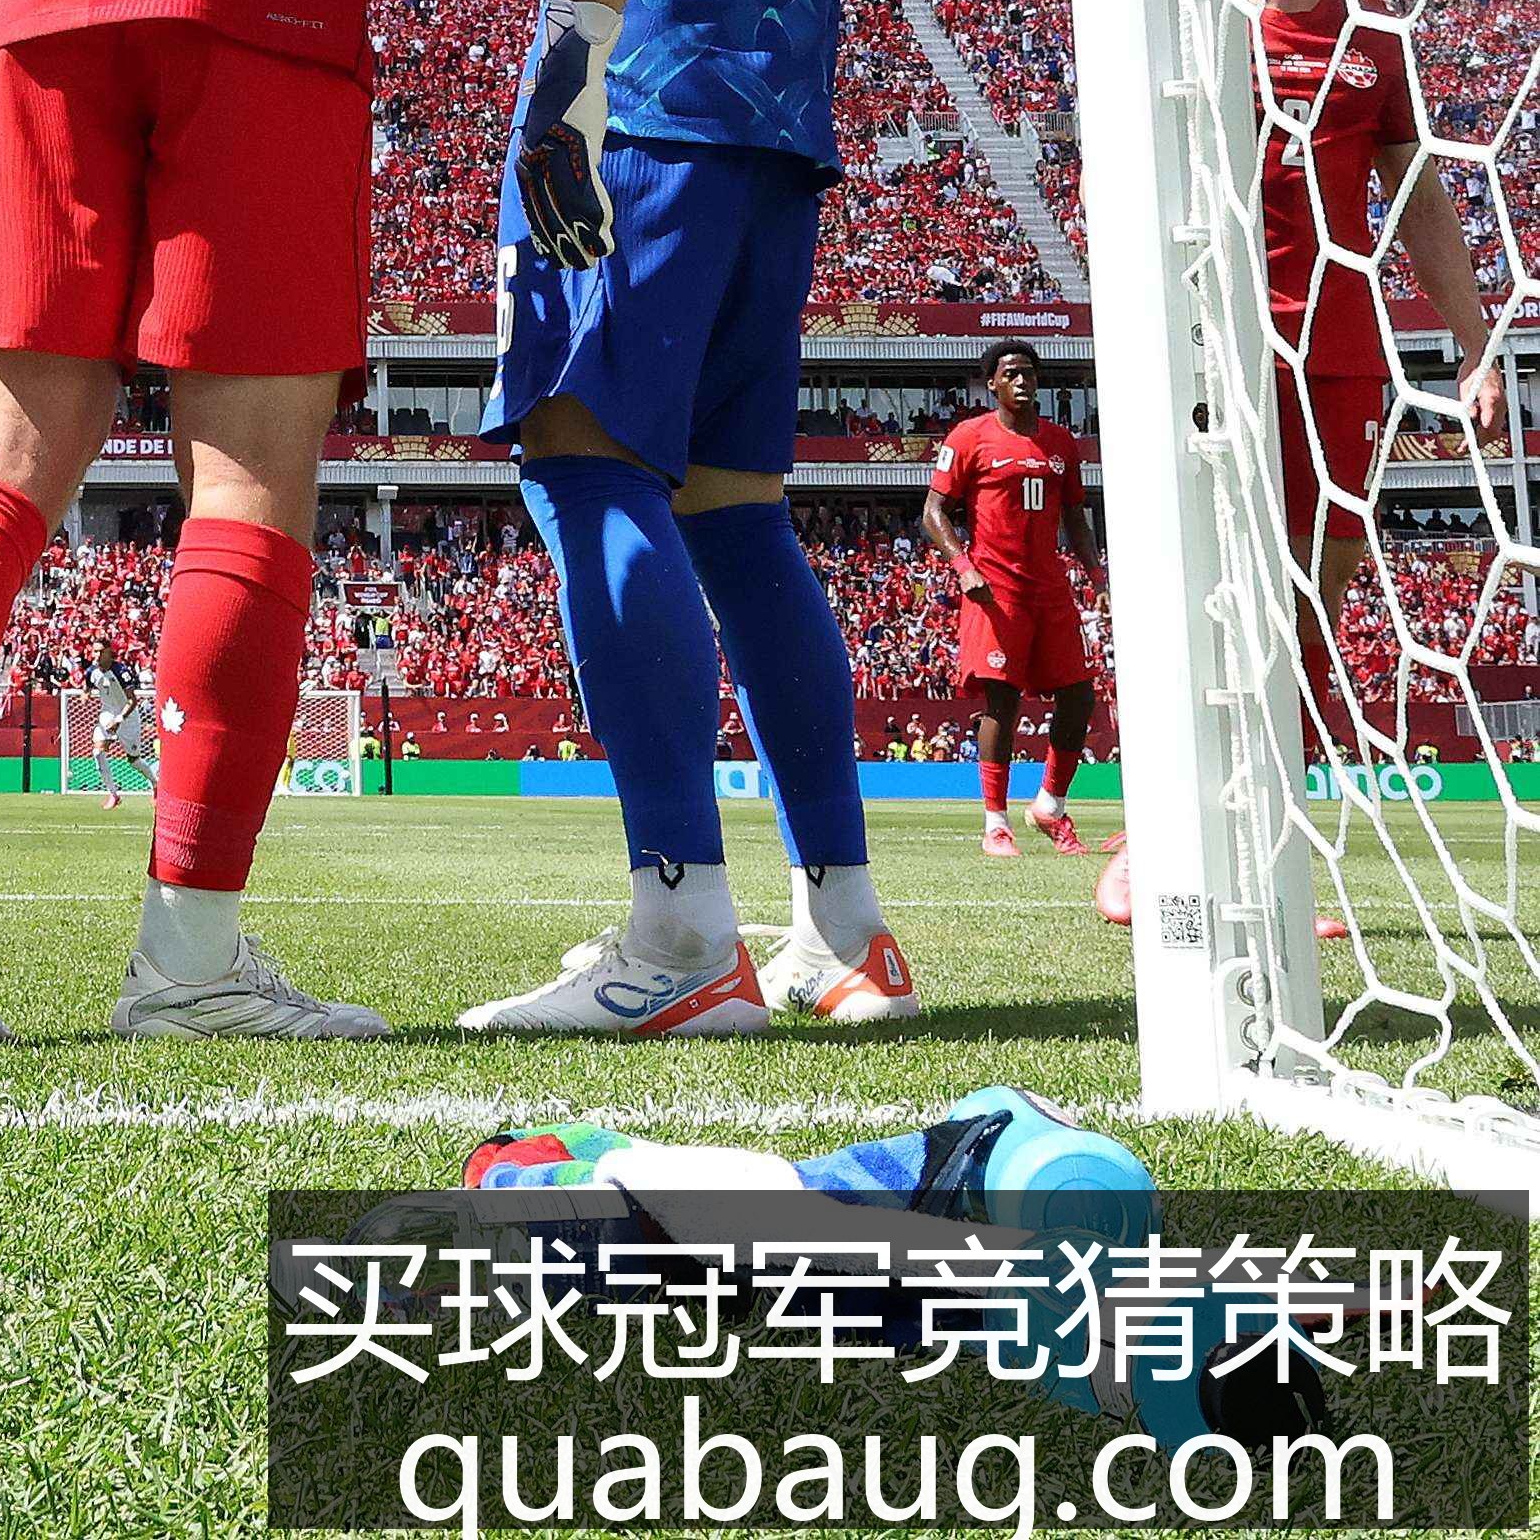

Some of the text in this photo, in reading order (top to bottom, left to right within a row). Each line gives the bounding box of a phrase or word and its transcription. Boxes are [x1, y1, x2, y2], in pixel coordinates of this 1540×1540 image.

[979, 311, 1071, 330] #FIFAWorldCup
[101, 438, 138, 455] NDE
[140, 438, 164, 455] DE
[1022, 476, 1044, 511] 10
[1306, 764, 1442, 801] amco
